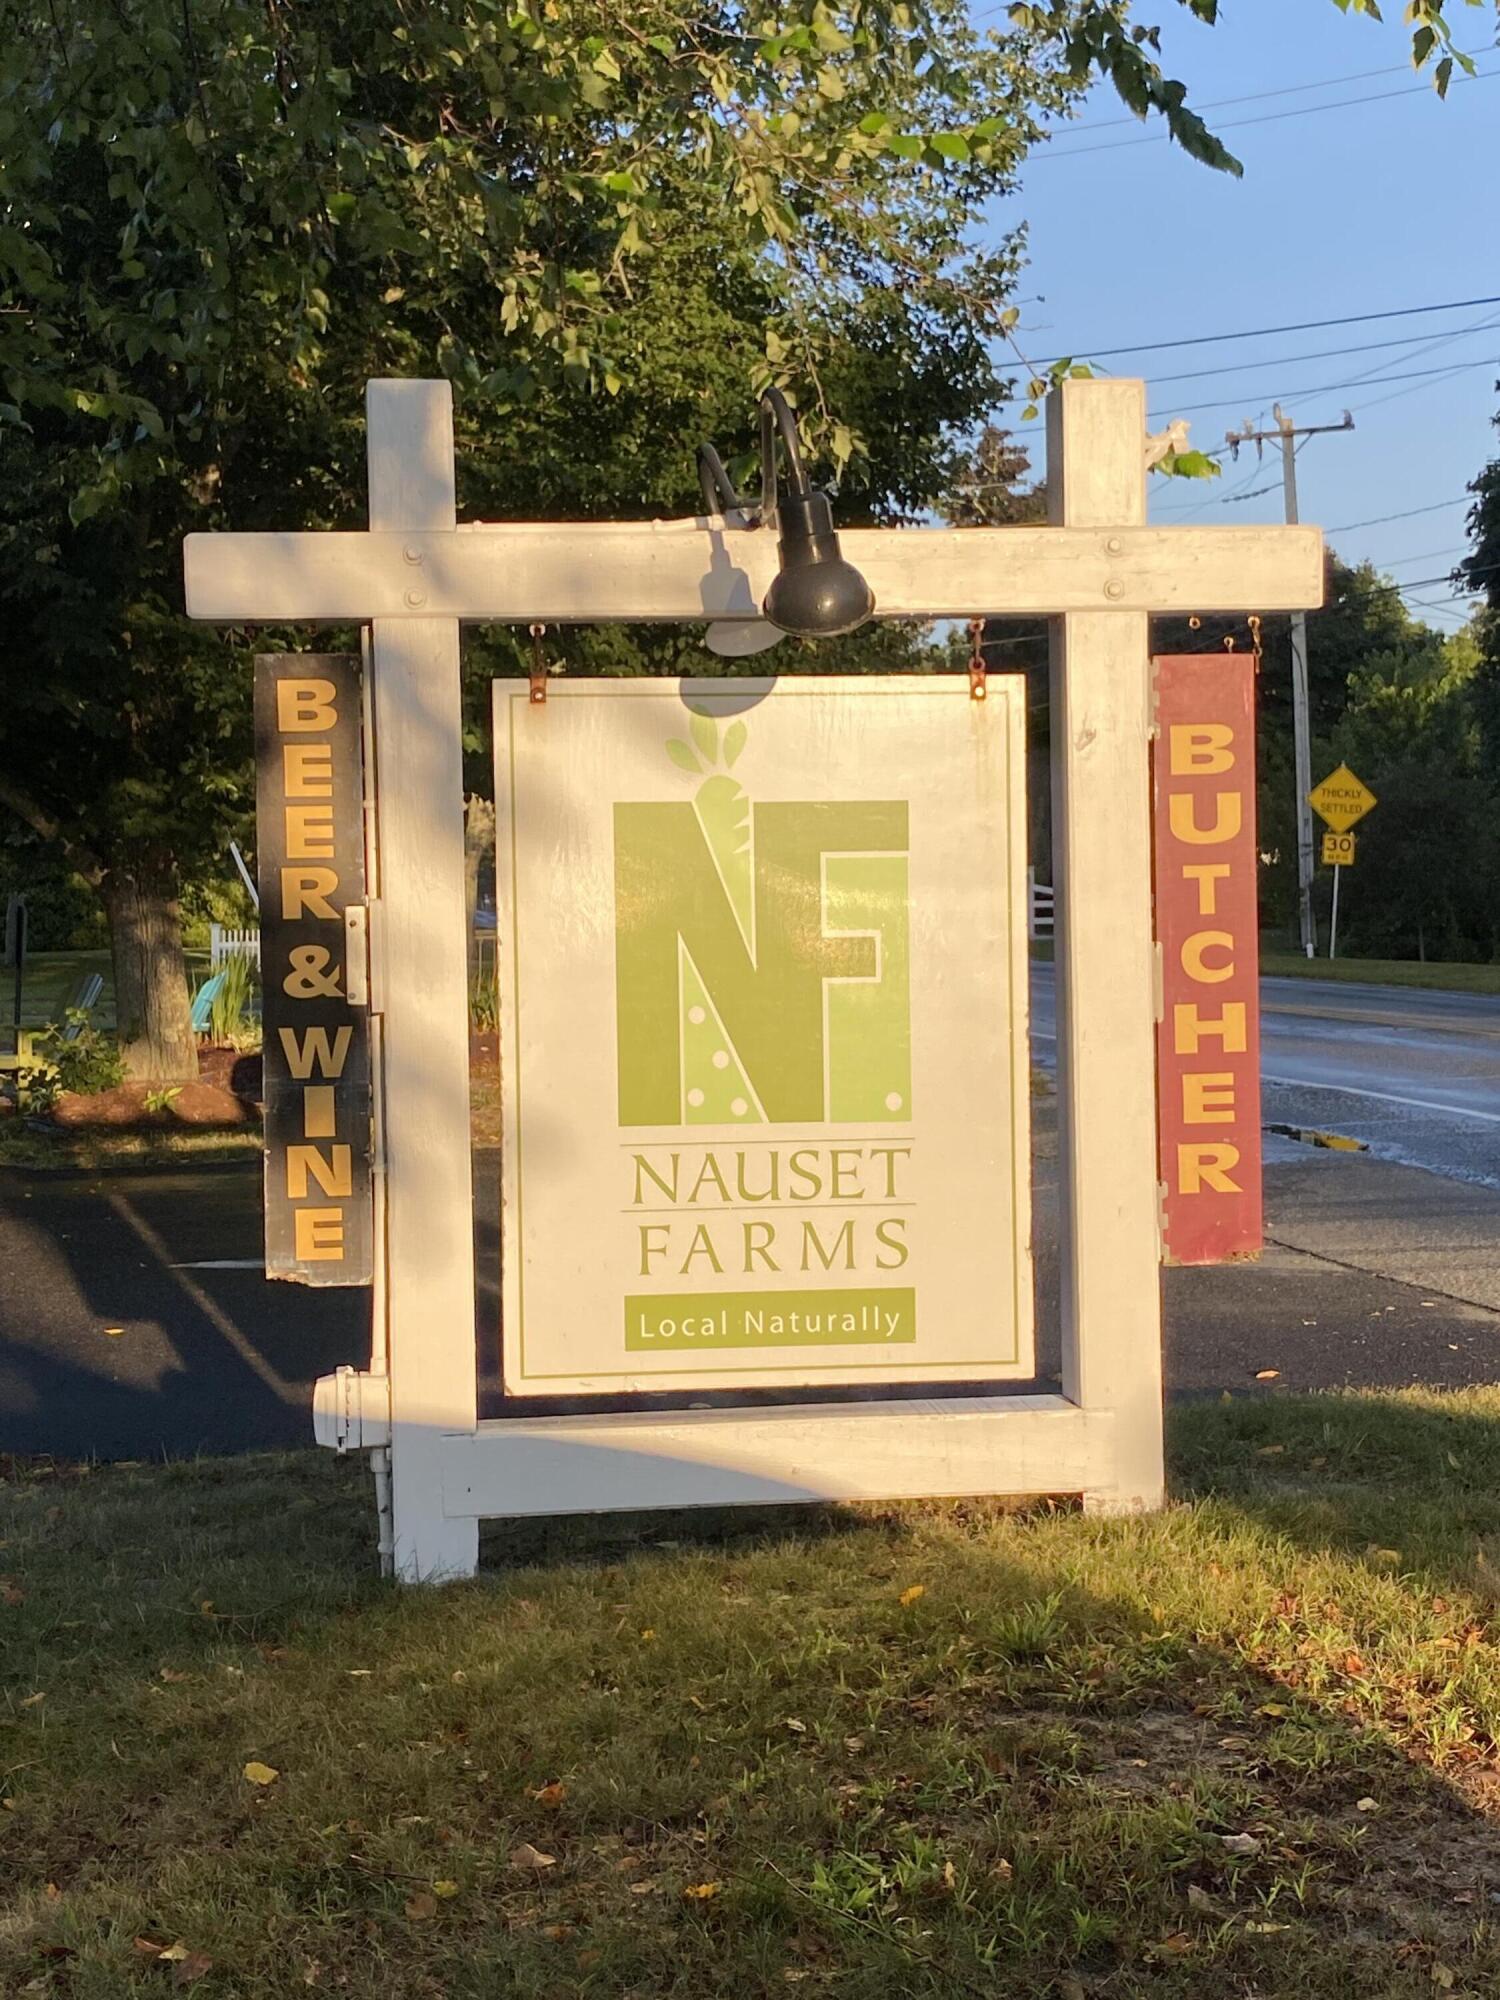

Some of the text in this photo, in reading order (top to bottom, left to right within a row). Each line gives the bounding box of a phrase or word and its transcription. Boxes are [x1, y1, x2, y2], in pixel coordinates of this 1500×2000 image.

[1320, 803, 1363, 814] SETTLED
[1321, 788, 1362, 799] THICKLY
[1326, 837, 1351, 852] 30
[276, 678, 354, 1261] BEER & WINE
[613, 799, 912, 1128] NF
[1168, 722, 1247, 1195] BUTCHER
[631, 1147, 912, 1204] NAUSET
[639, 1218, 909, 1276] FARMS
[640, 1305, 900, 1338] Local Naturally
